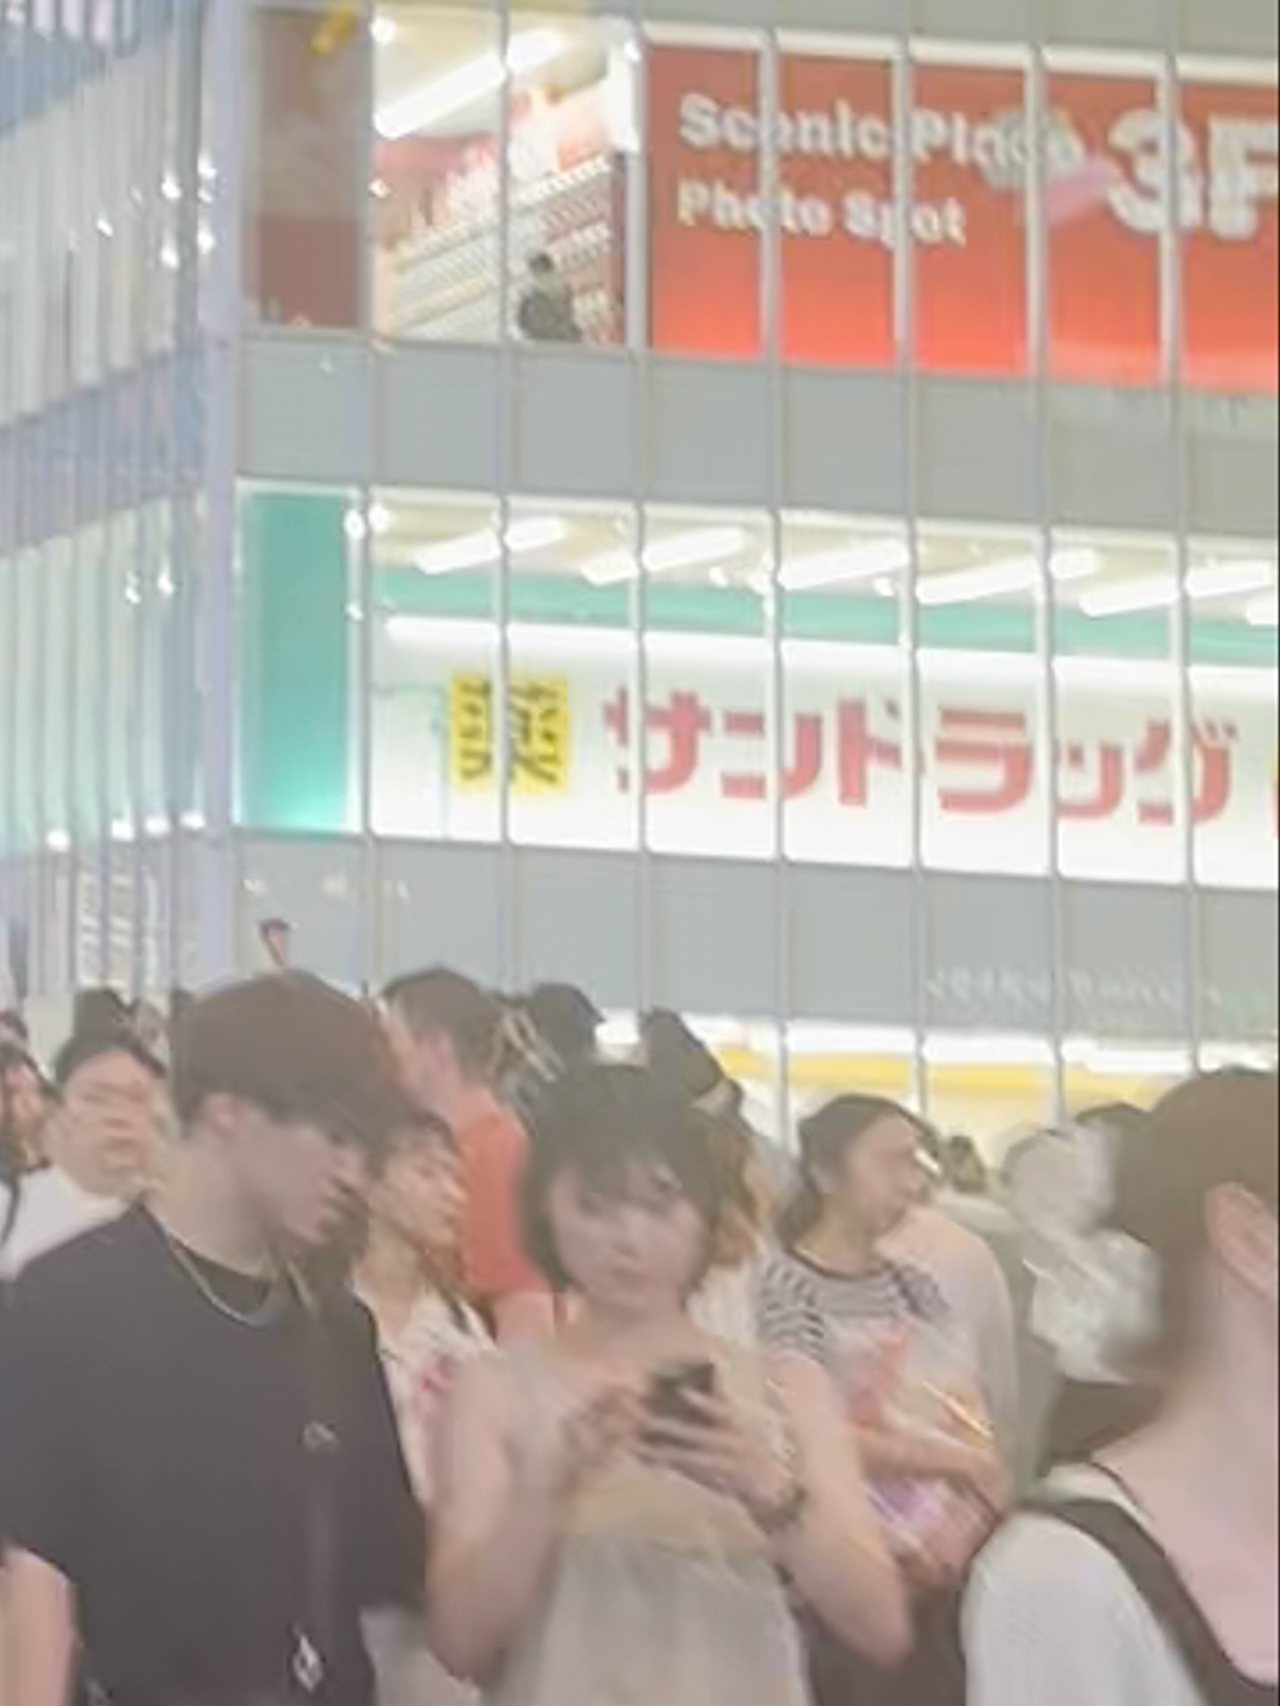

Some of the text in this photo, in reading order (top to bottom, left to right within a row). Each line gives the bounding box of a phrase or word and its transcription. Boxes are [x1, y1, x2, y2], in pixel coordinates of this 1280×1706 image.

[678, 91, 891, 160] Scenic
[676, 177, 969, 250] Photo Spot
[600, 685, 1241, 828] サンドラッグ
